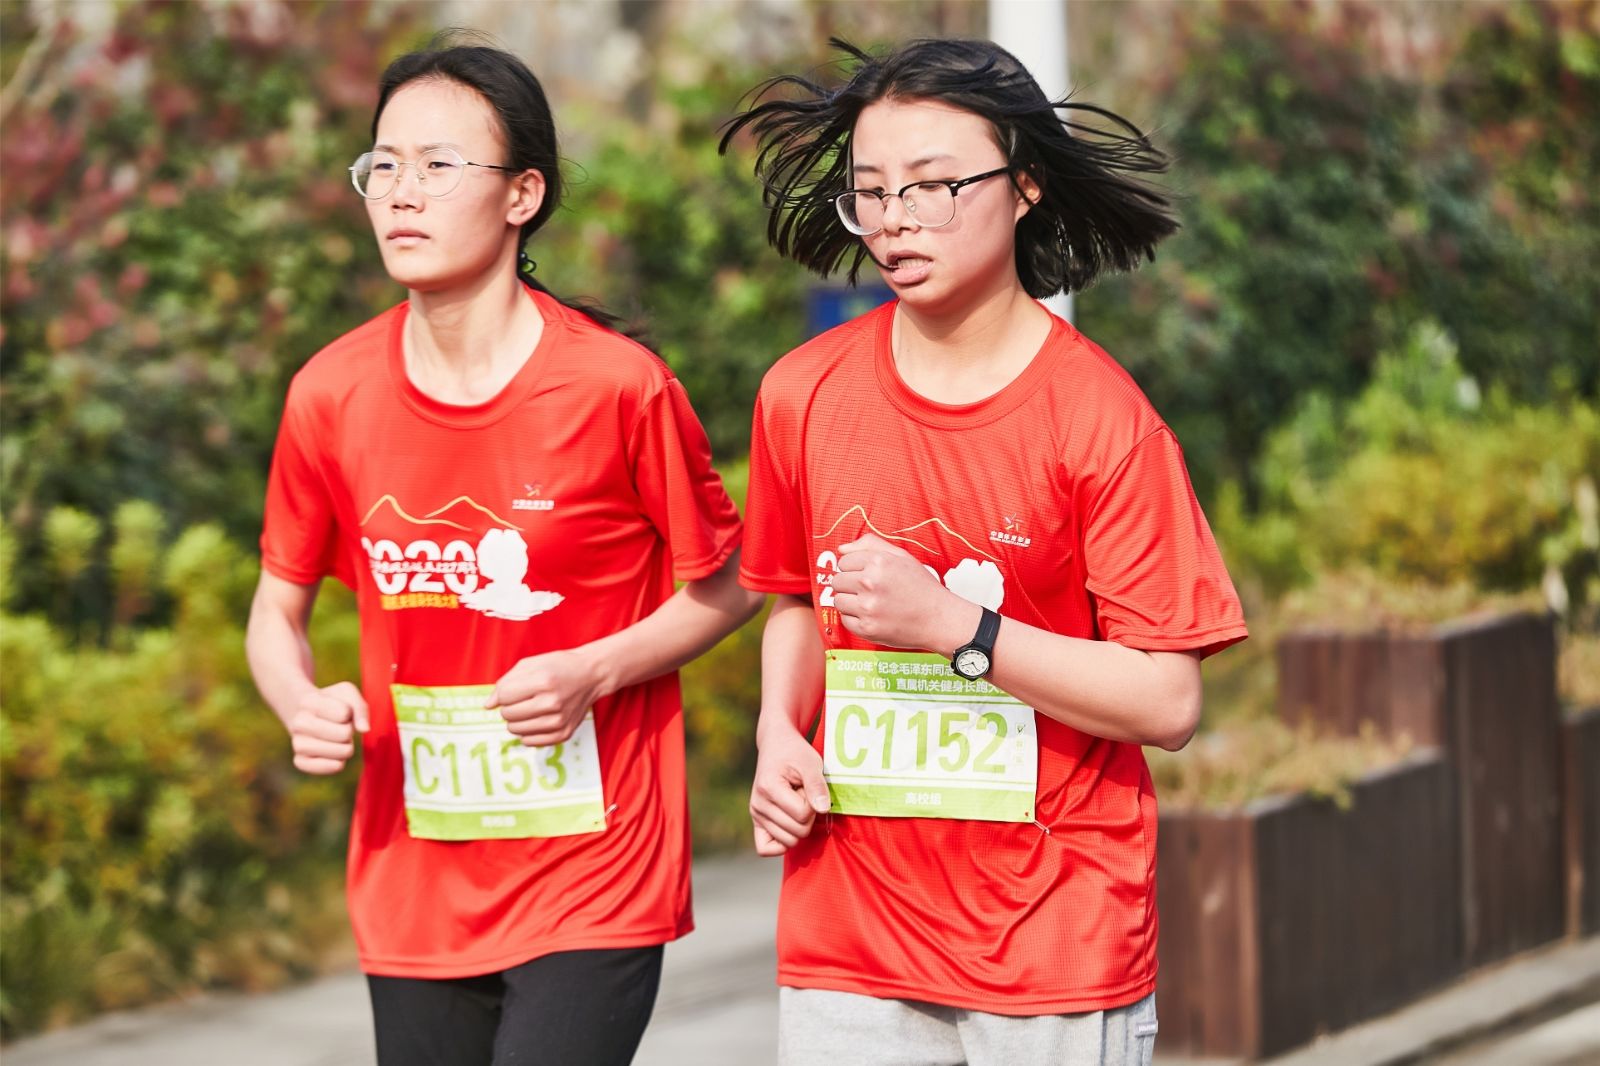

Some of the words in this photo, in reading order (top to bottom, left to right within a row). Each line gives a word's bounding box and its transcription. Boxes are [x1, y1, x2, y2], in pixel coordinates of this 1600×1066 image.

[361, 537, 479, 595] 020
[411, 737, 567, 796] C1153
[834, 704, 1008, 774] C1152
